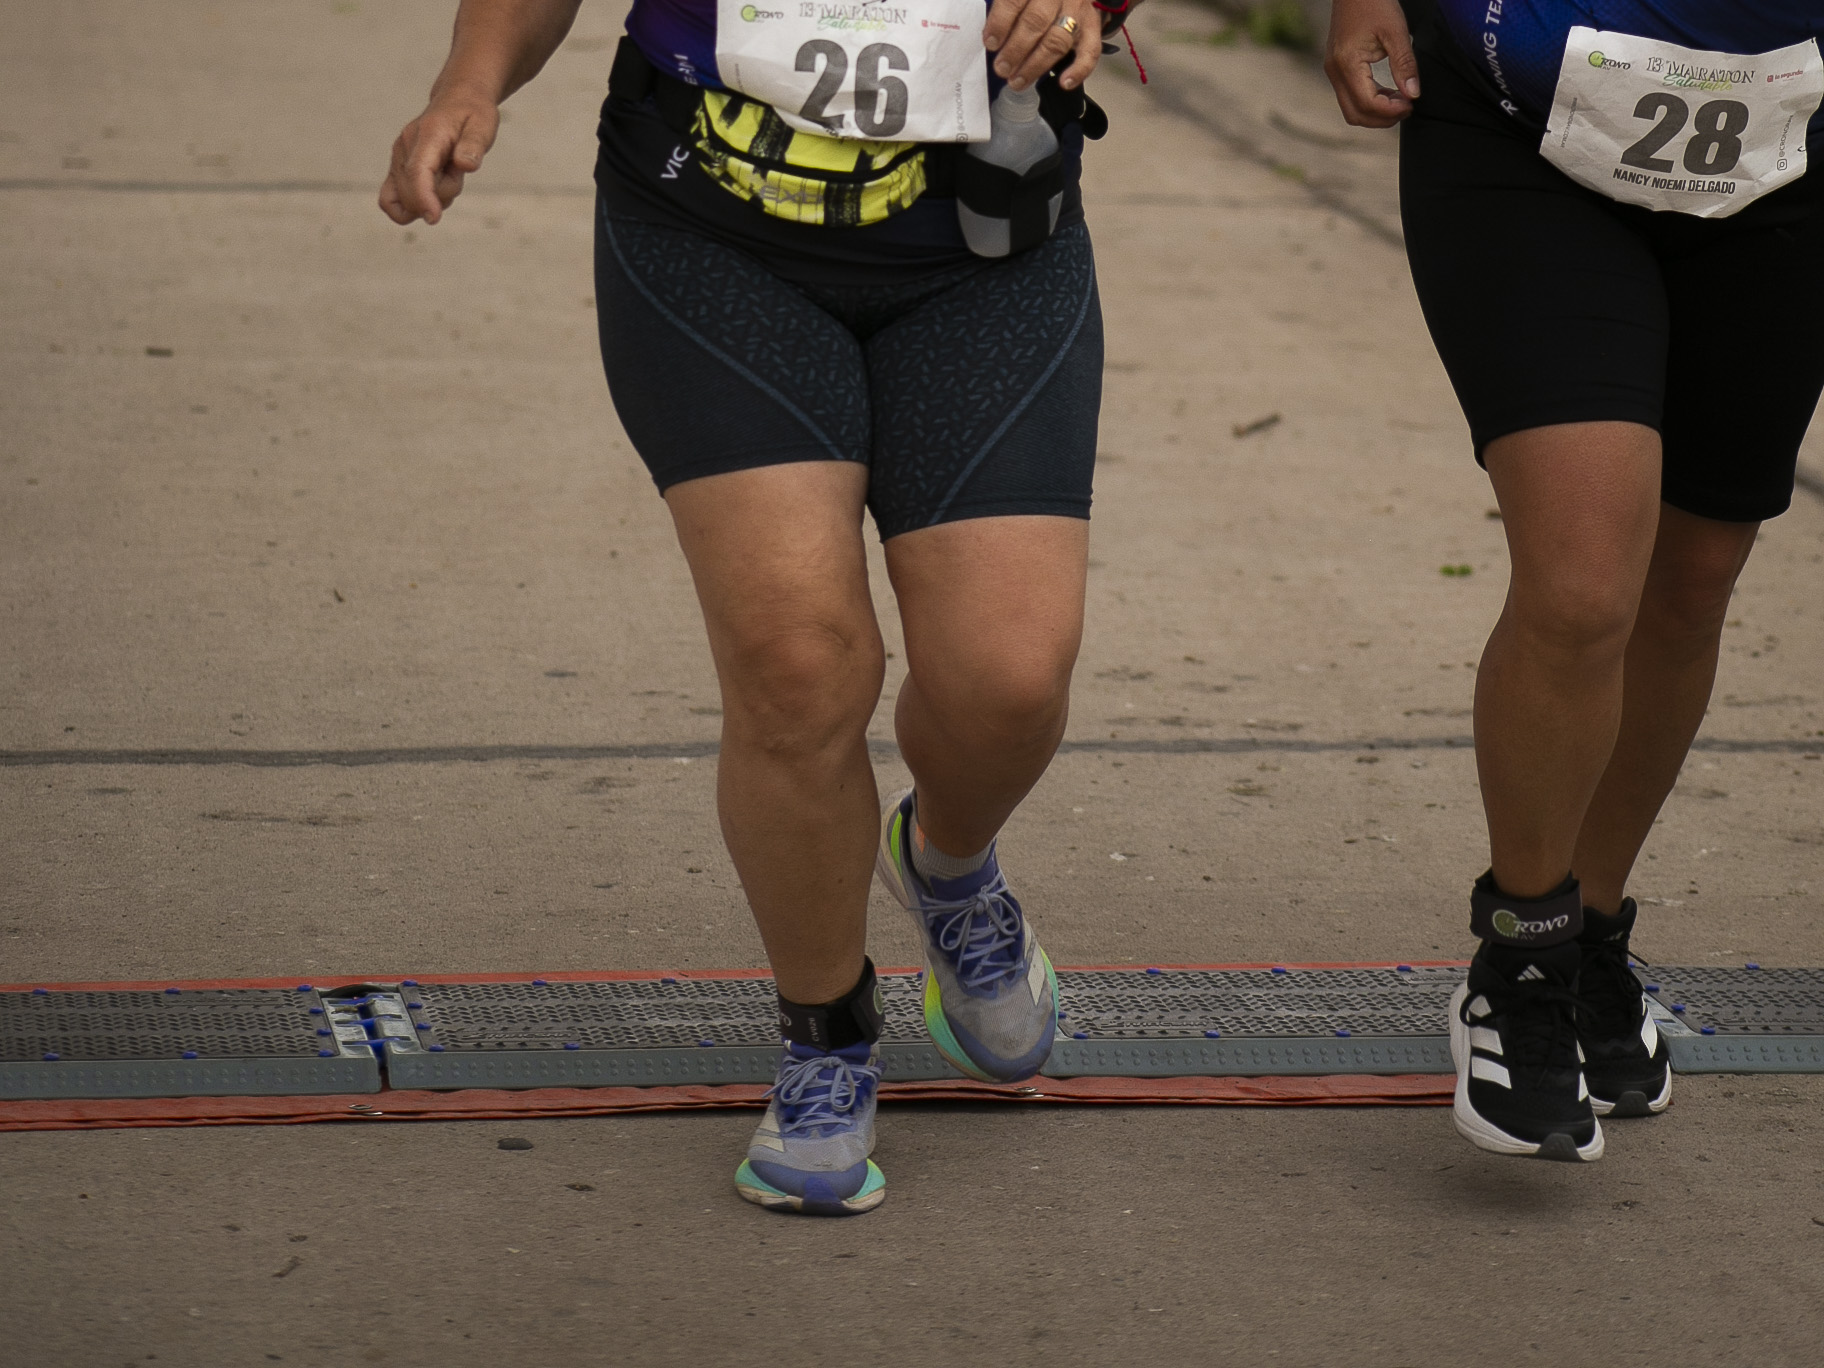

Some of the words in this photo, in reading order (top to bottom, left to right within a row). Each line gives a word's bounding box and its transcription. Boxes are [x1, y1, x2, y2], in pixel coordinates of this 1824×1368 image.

[794, 38, 910, 137] 26
[1483, 31, 1519, 116] RNNING
[1661, 72, 1734, 92] Saludable
[1664, 59, 1756, 85] MARATON
[1619, 91, 1750, 177] 28
[660, 143, 691, 180] VIC
[1612, 167, 1651, 186] NANCY
[1651, 176, 1687, 191] NOEMI
[1687, 179, 1737, 195] DELGADO
